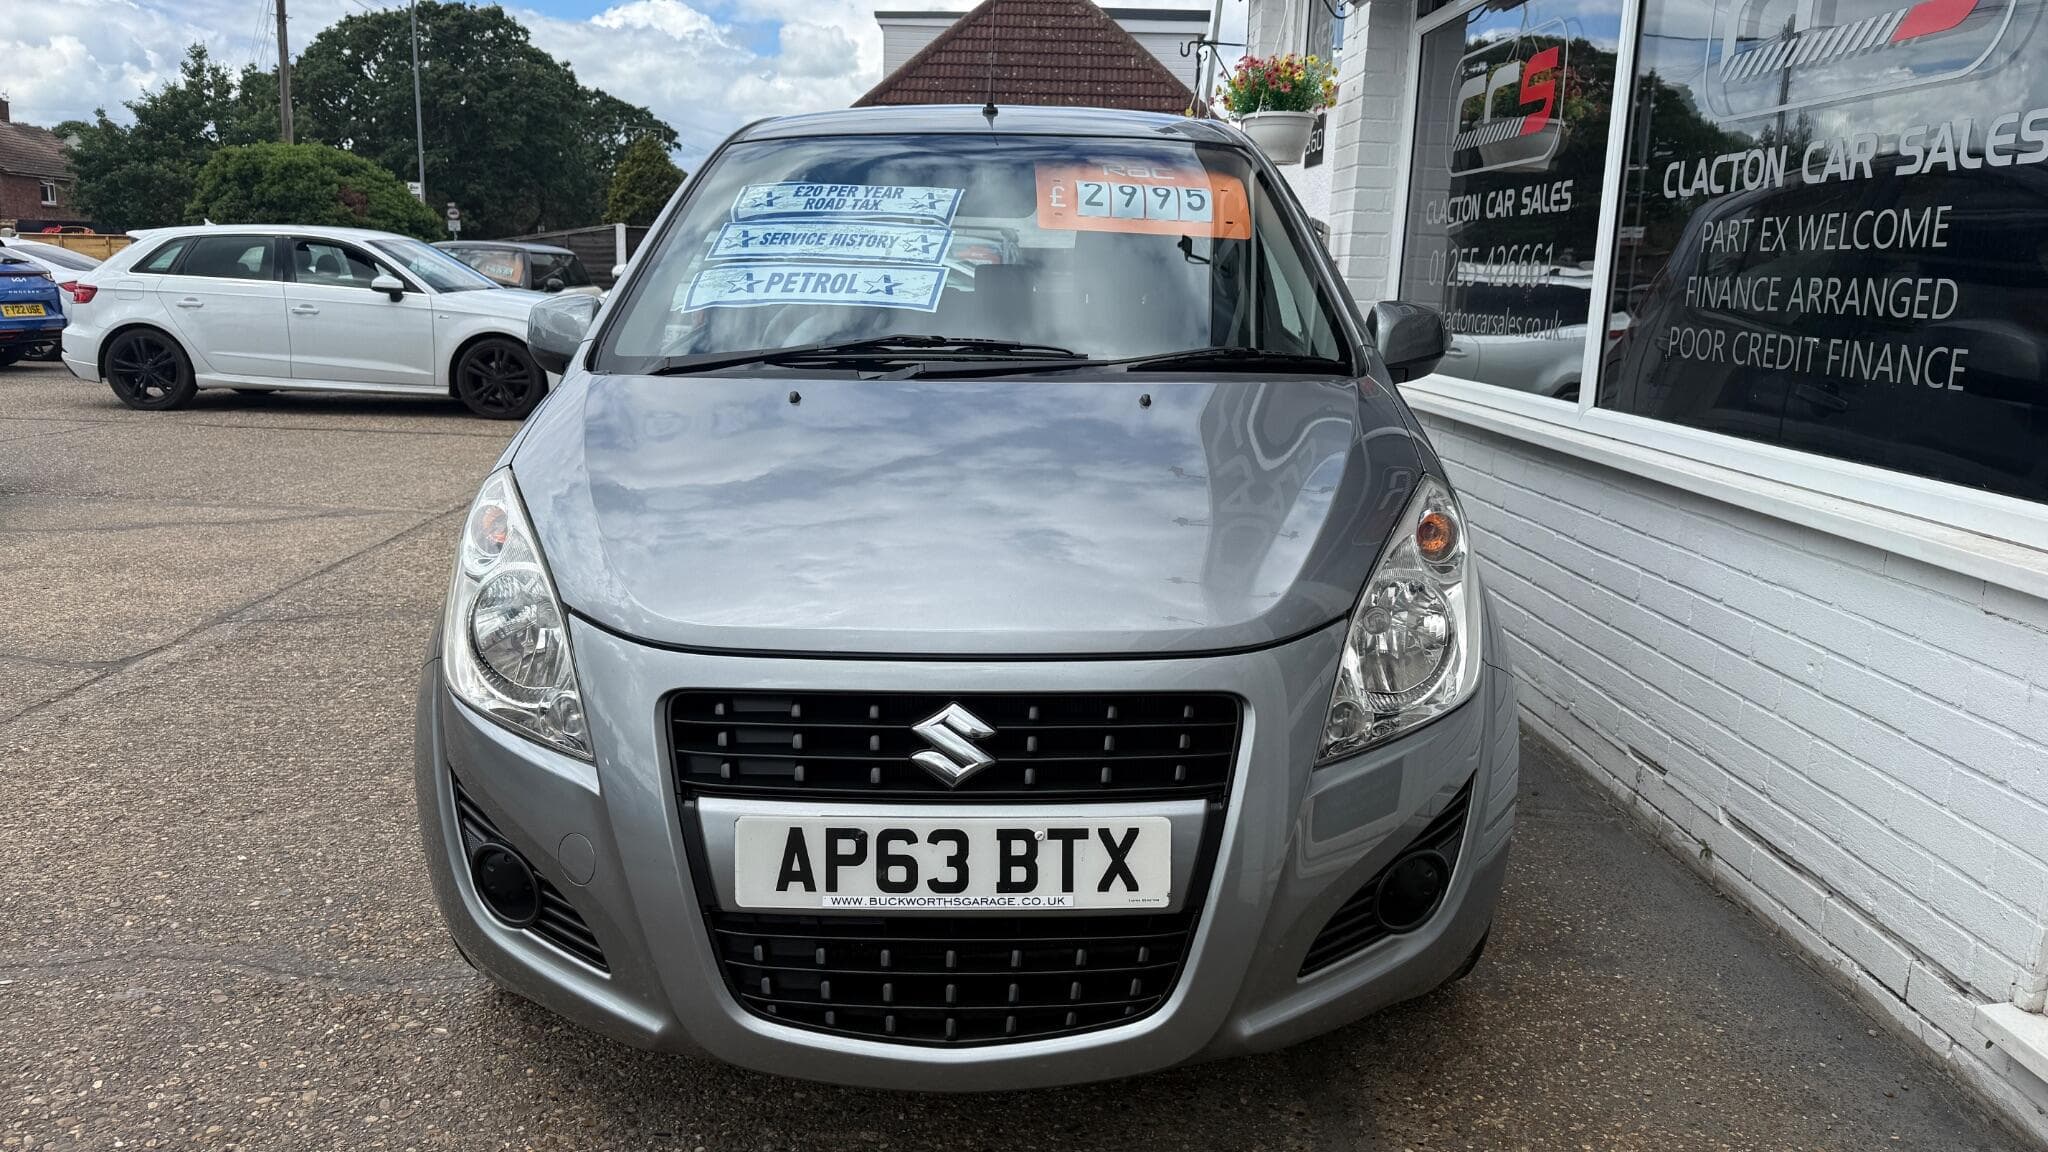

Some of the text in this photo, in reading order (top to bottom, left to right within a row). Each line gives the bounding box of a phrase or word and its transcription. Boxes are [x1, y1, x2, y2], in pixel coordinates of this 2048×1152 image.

[1663, 108, 2048, 199] CLACTON CAR SALES
[793, 185, 905, 200] £20 PER YEAR
[803, 197, 882, 212] ROAD TAX
[1426, 179, 1574, 225] CLACTON CAR SALES
[759, 232, 900, 249] SERVICE HISTORY
[1701, 205, 1953, 253] PART EX WELCOME
[764, 271, 860, 295] PETROL
[1429, 246, 1479, 287] 01255
[1685, 276, 1959, 320] FINANCE ARRANGED
[1441, 304, 1563, 342] lactoncarsales.co.uk
[1668, 326, 1969, 391] POOR CREDIT FINANCE
[776, 827, 1140, 894] AP63 BTX
[830, 896, 1066, 907] WWW.BUCKWORTHSGARAGE.CO.UK
